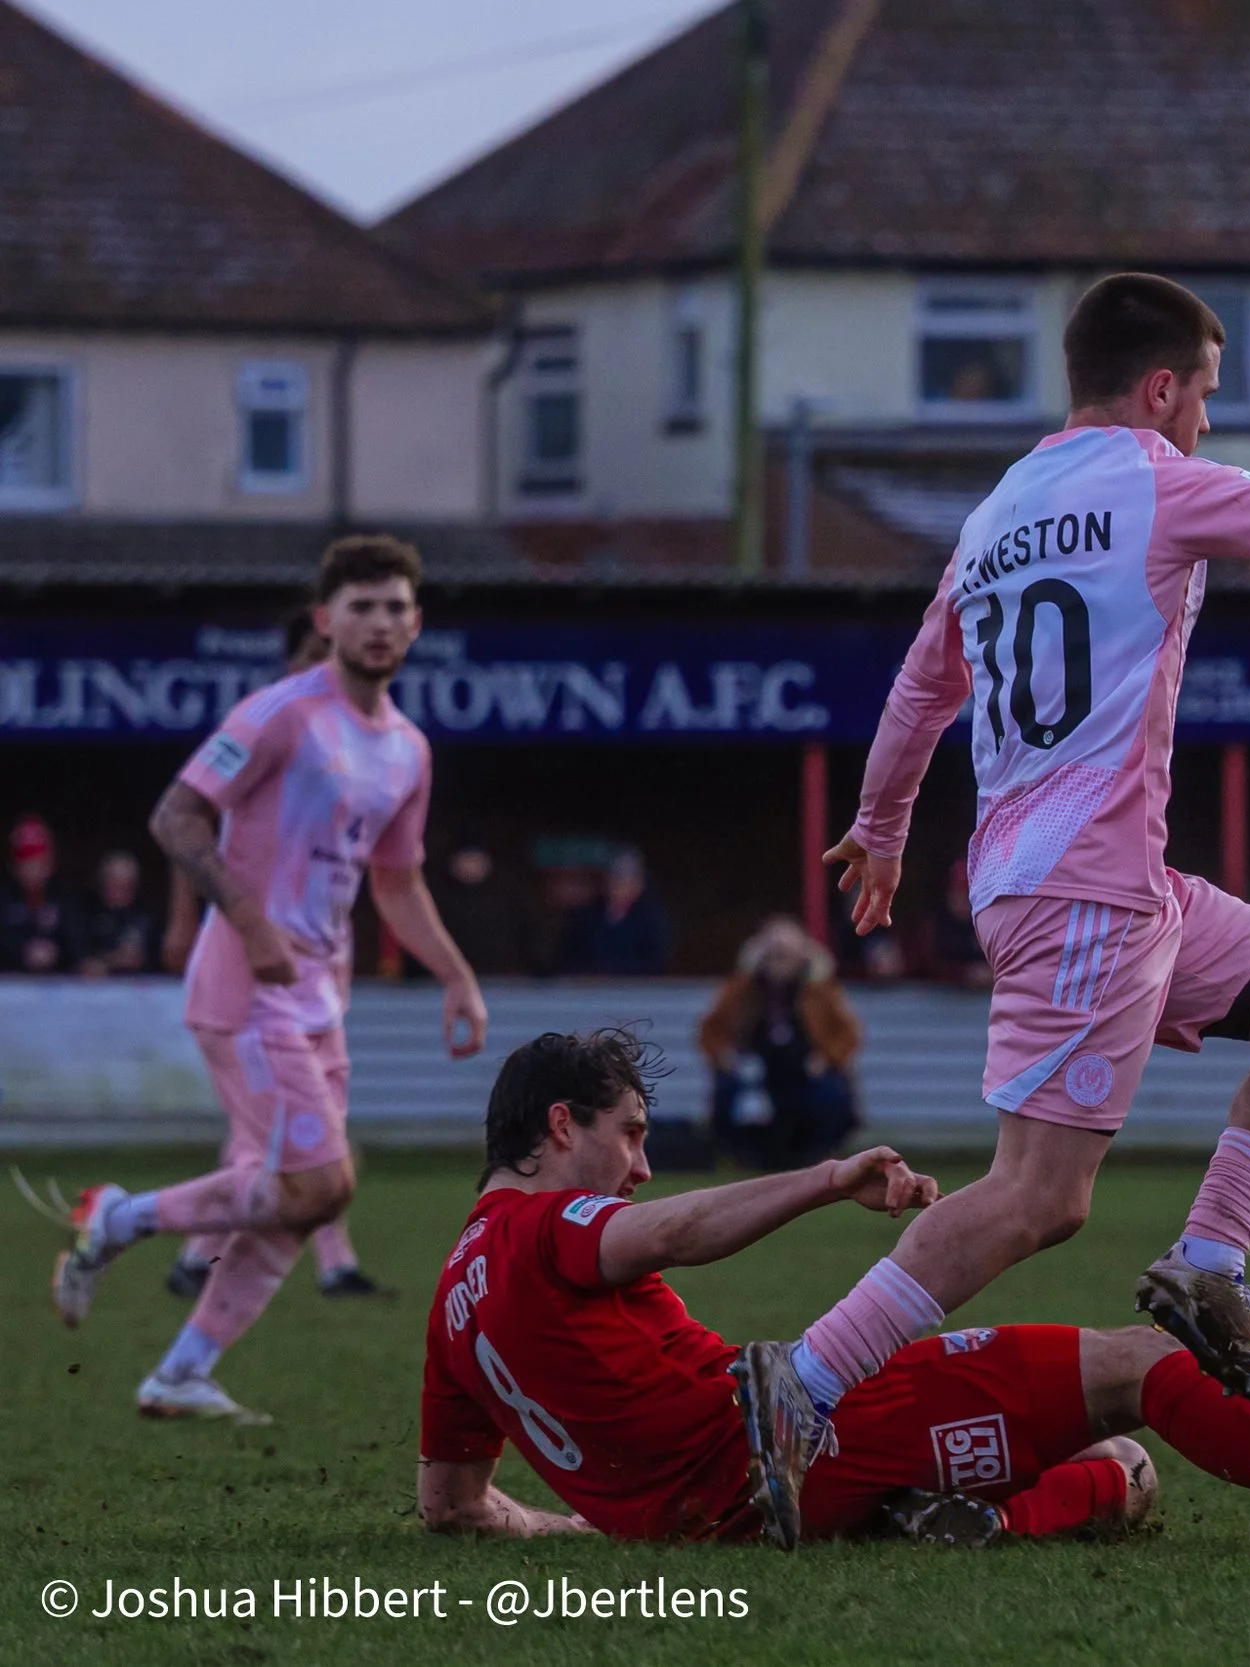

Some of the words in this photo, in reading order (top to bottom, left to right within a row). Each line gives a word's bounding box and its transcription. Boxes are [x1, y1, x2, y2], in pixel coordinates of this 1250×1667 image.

[962, 511, 1111, 594] T.WESTON
[976, 577, 1092, 755] 10
[475, 1330, 584, 1472] 8
[944, 1429, 975, 1488] TIG
[968, 1426, 1001, 1479] OLI
